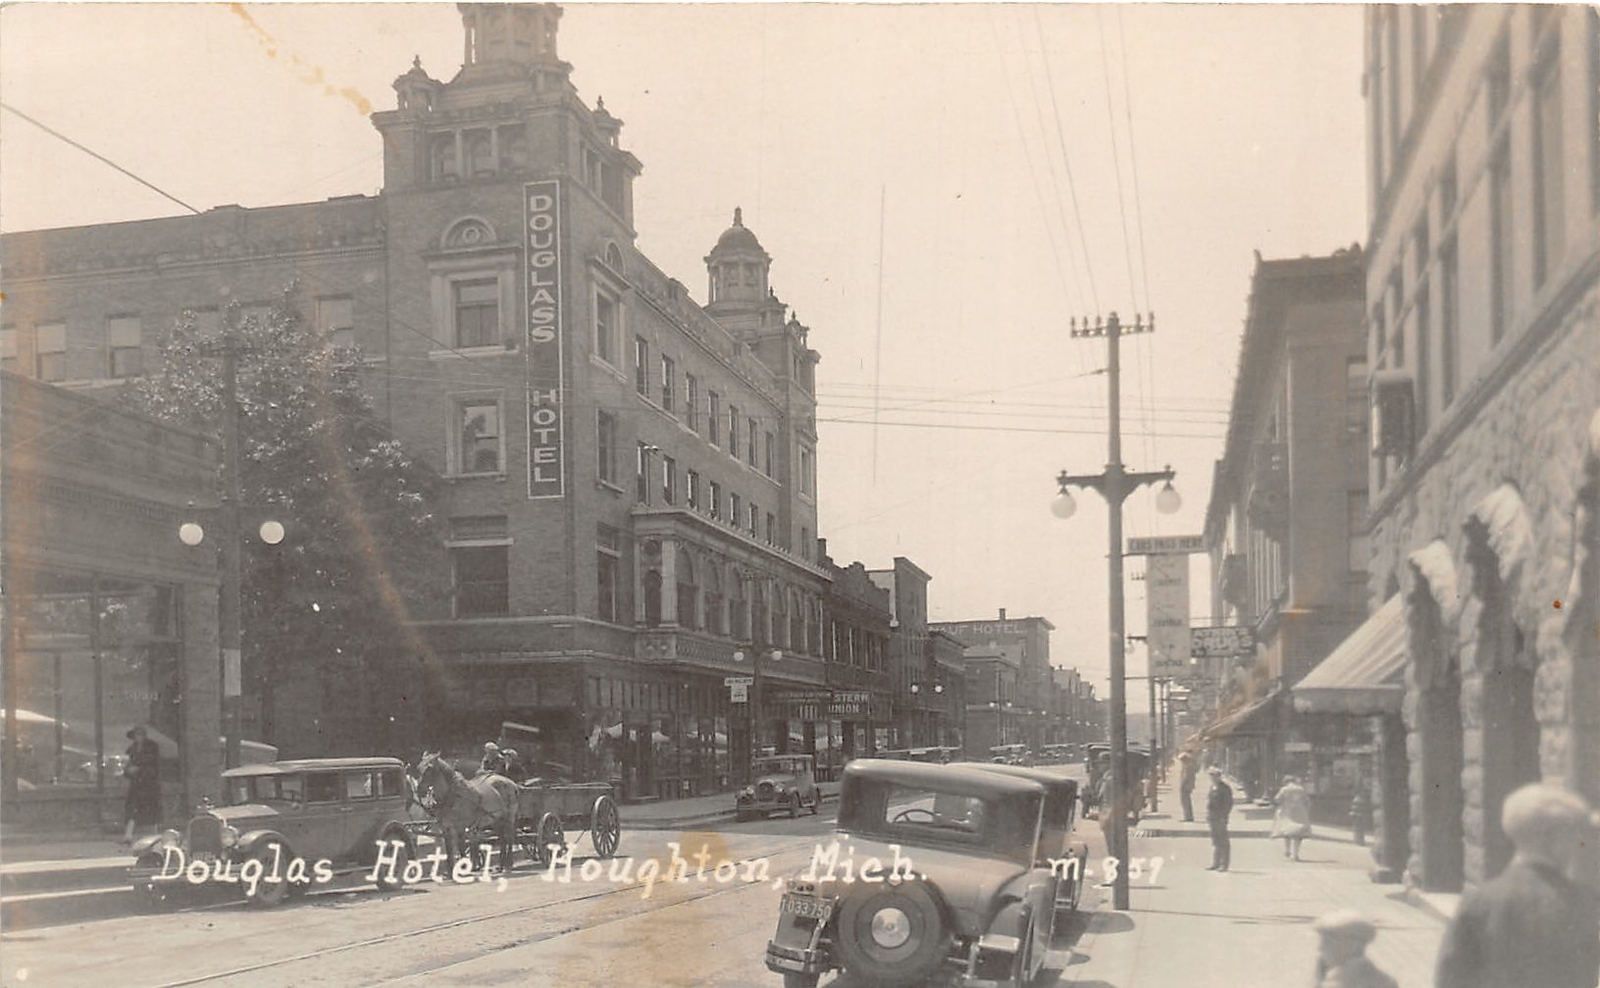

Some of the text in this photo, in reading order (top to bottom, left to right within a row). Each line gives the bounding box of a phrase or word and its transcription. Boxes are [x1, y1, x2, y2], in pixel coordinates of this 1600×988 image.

[529, 195, 557, 482] DOUGLASS HOTEL
[833, 693, 869, 703] STERN
